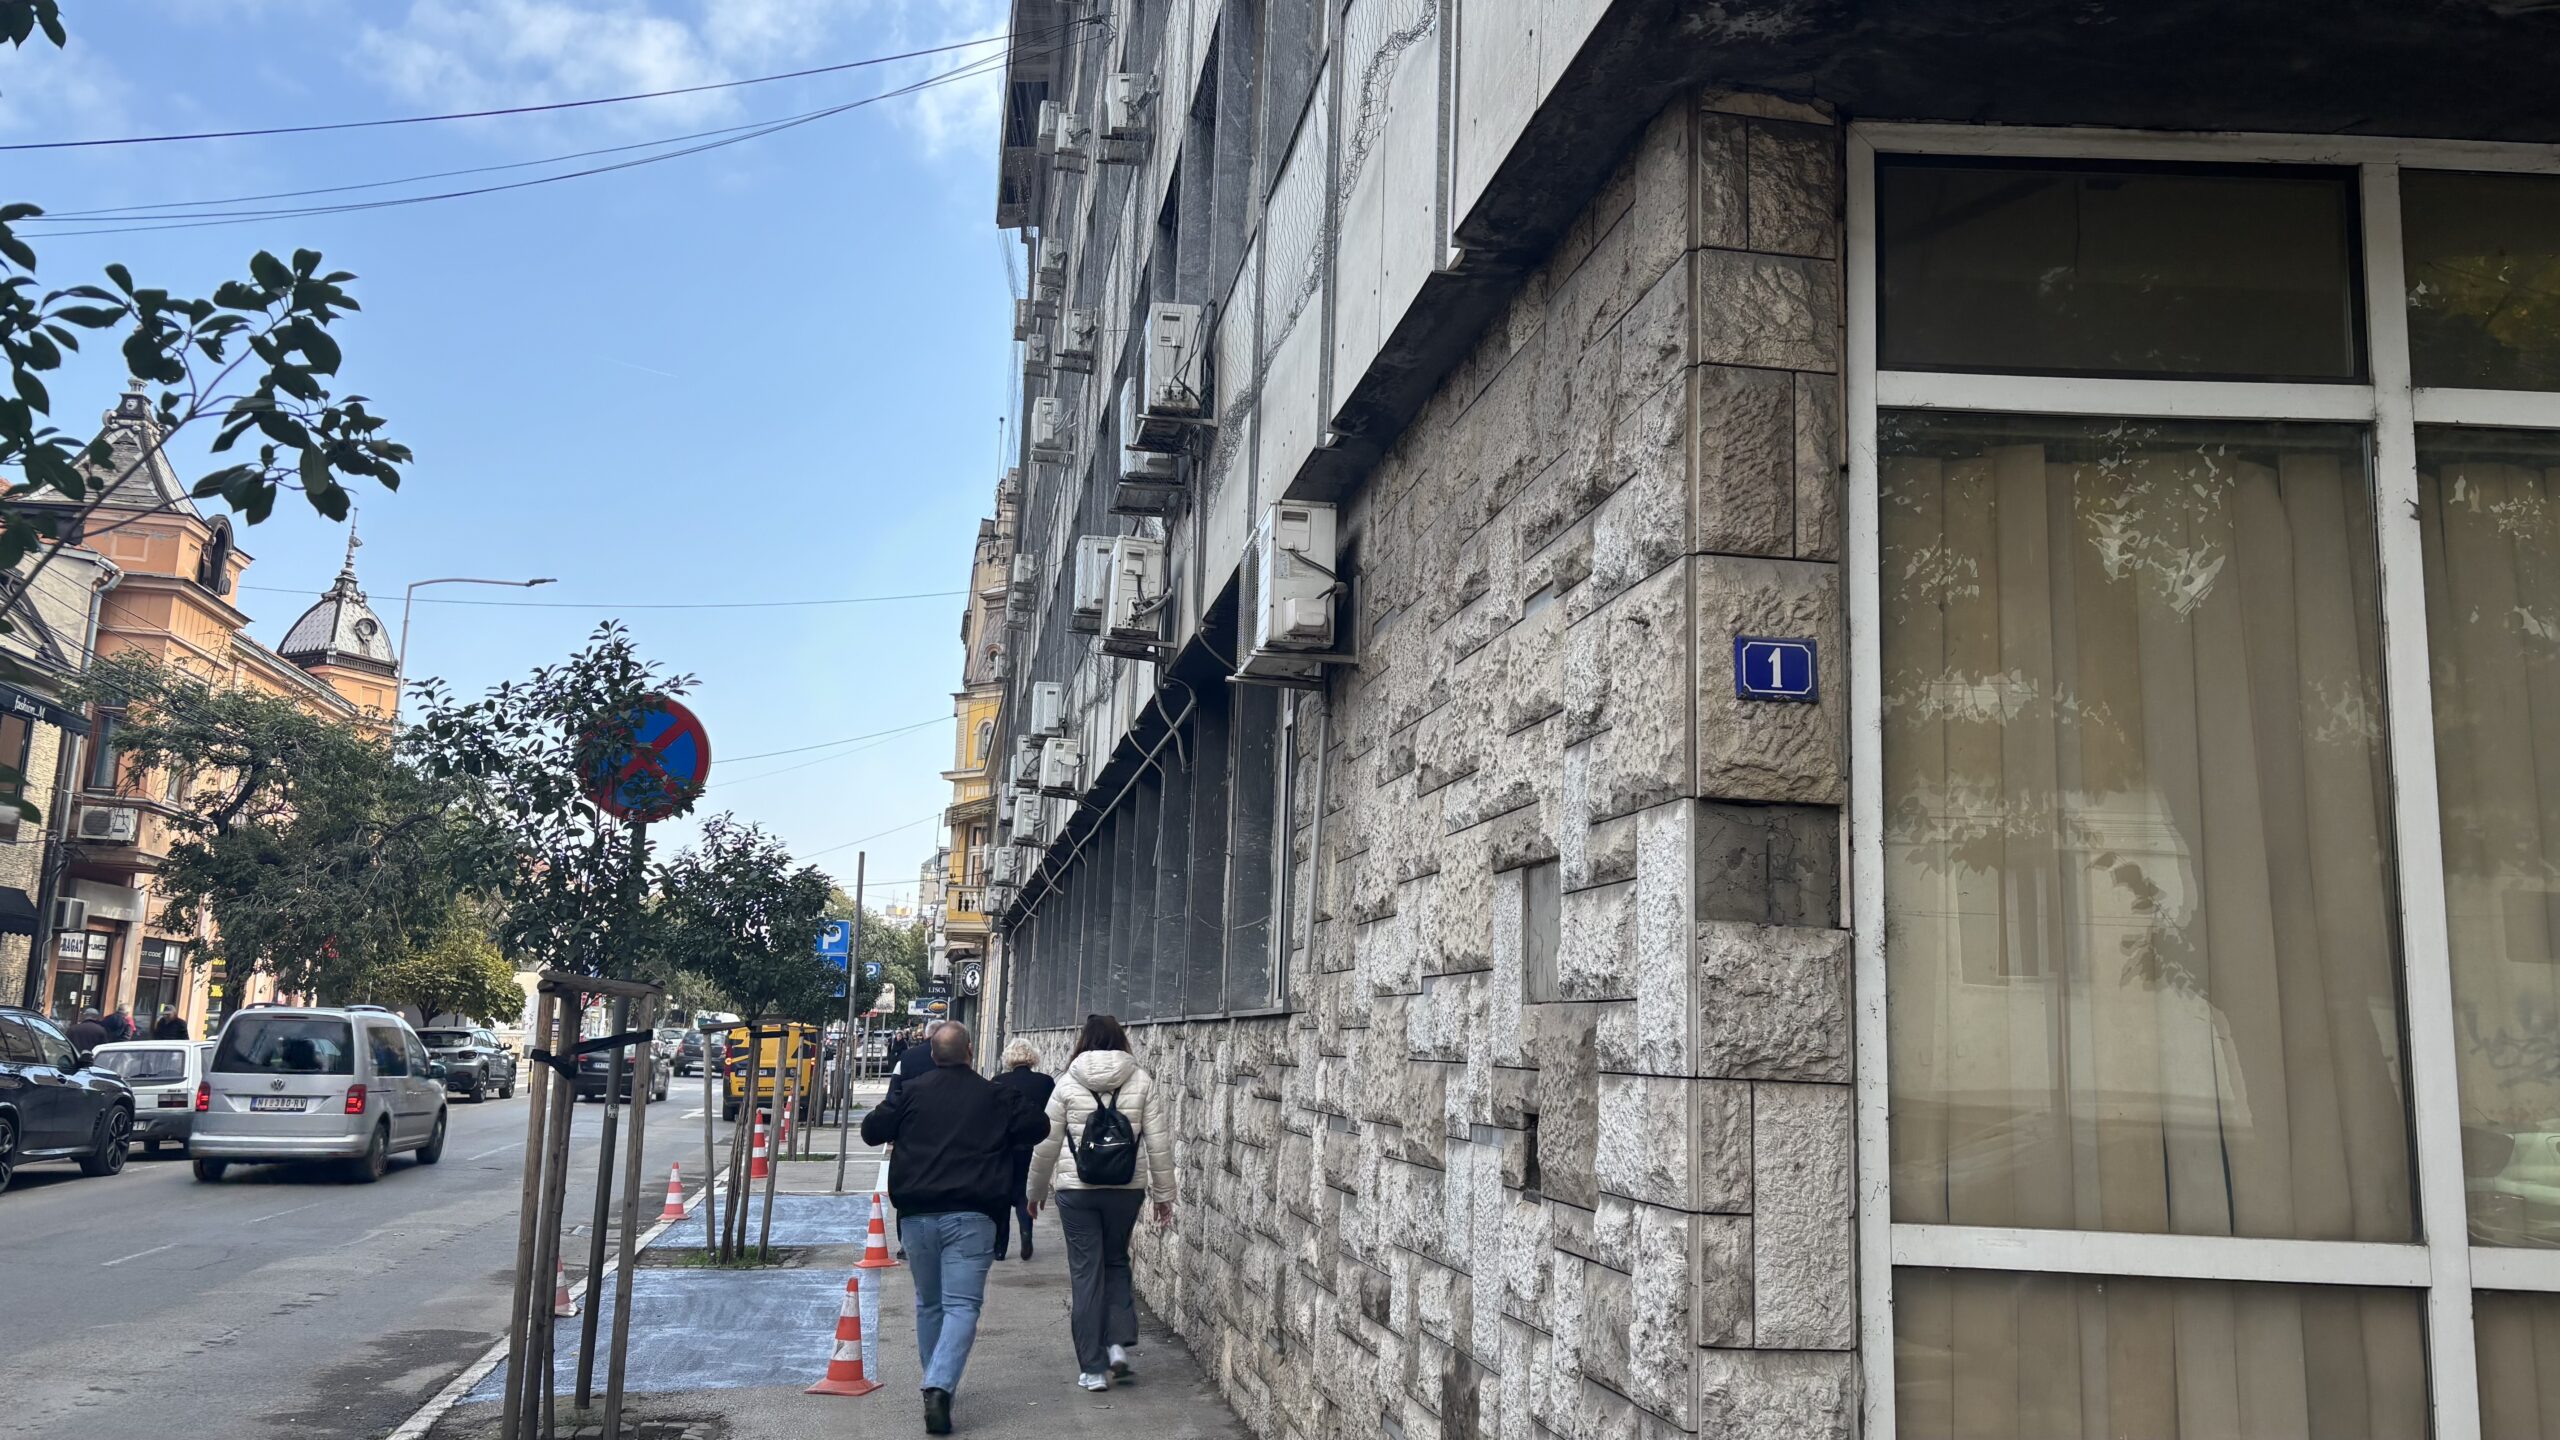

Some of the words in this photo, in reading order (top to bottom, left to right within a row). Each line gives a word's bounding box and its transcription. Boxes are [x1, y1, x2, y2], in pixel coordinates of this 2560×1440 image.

[1767, 647, 1783, 688] 1
[822, 924, 842, 950] P
[928, 986, 946, 994] LISCA
